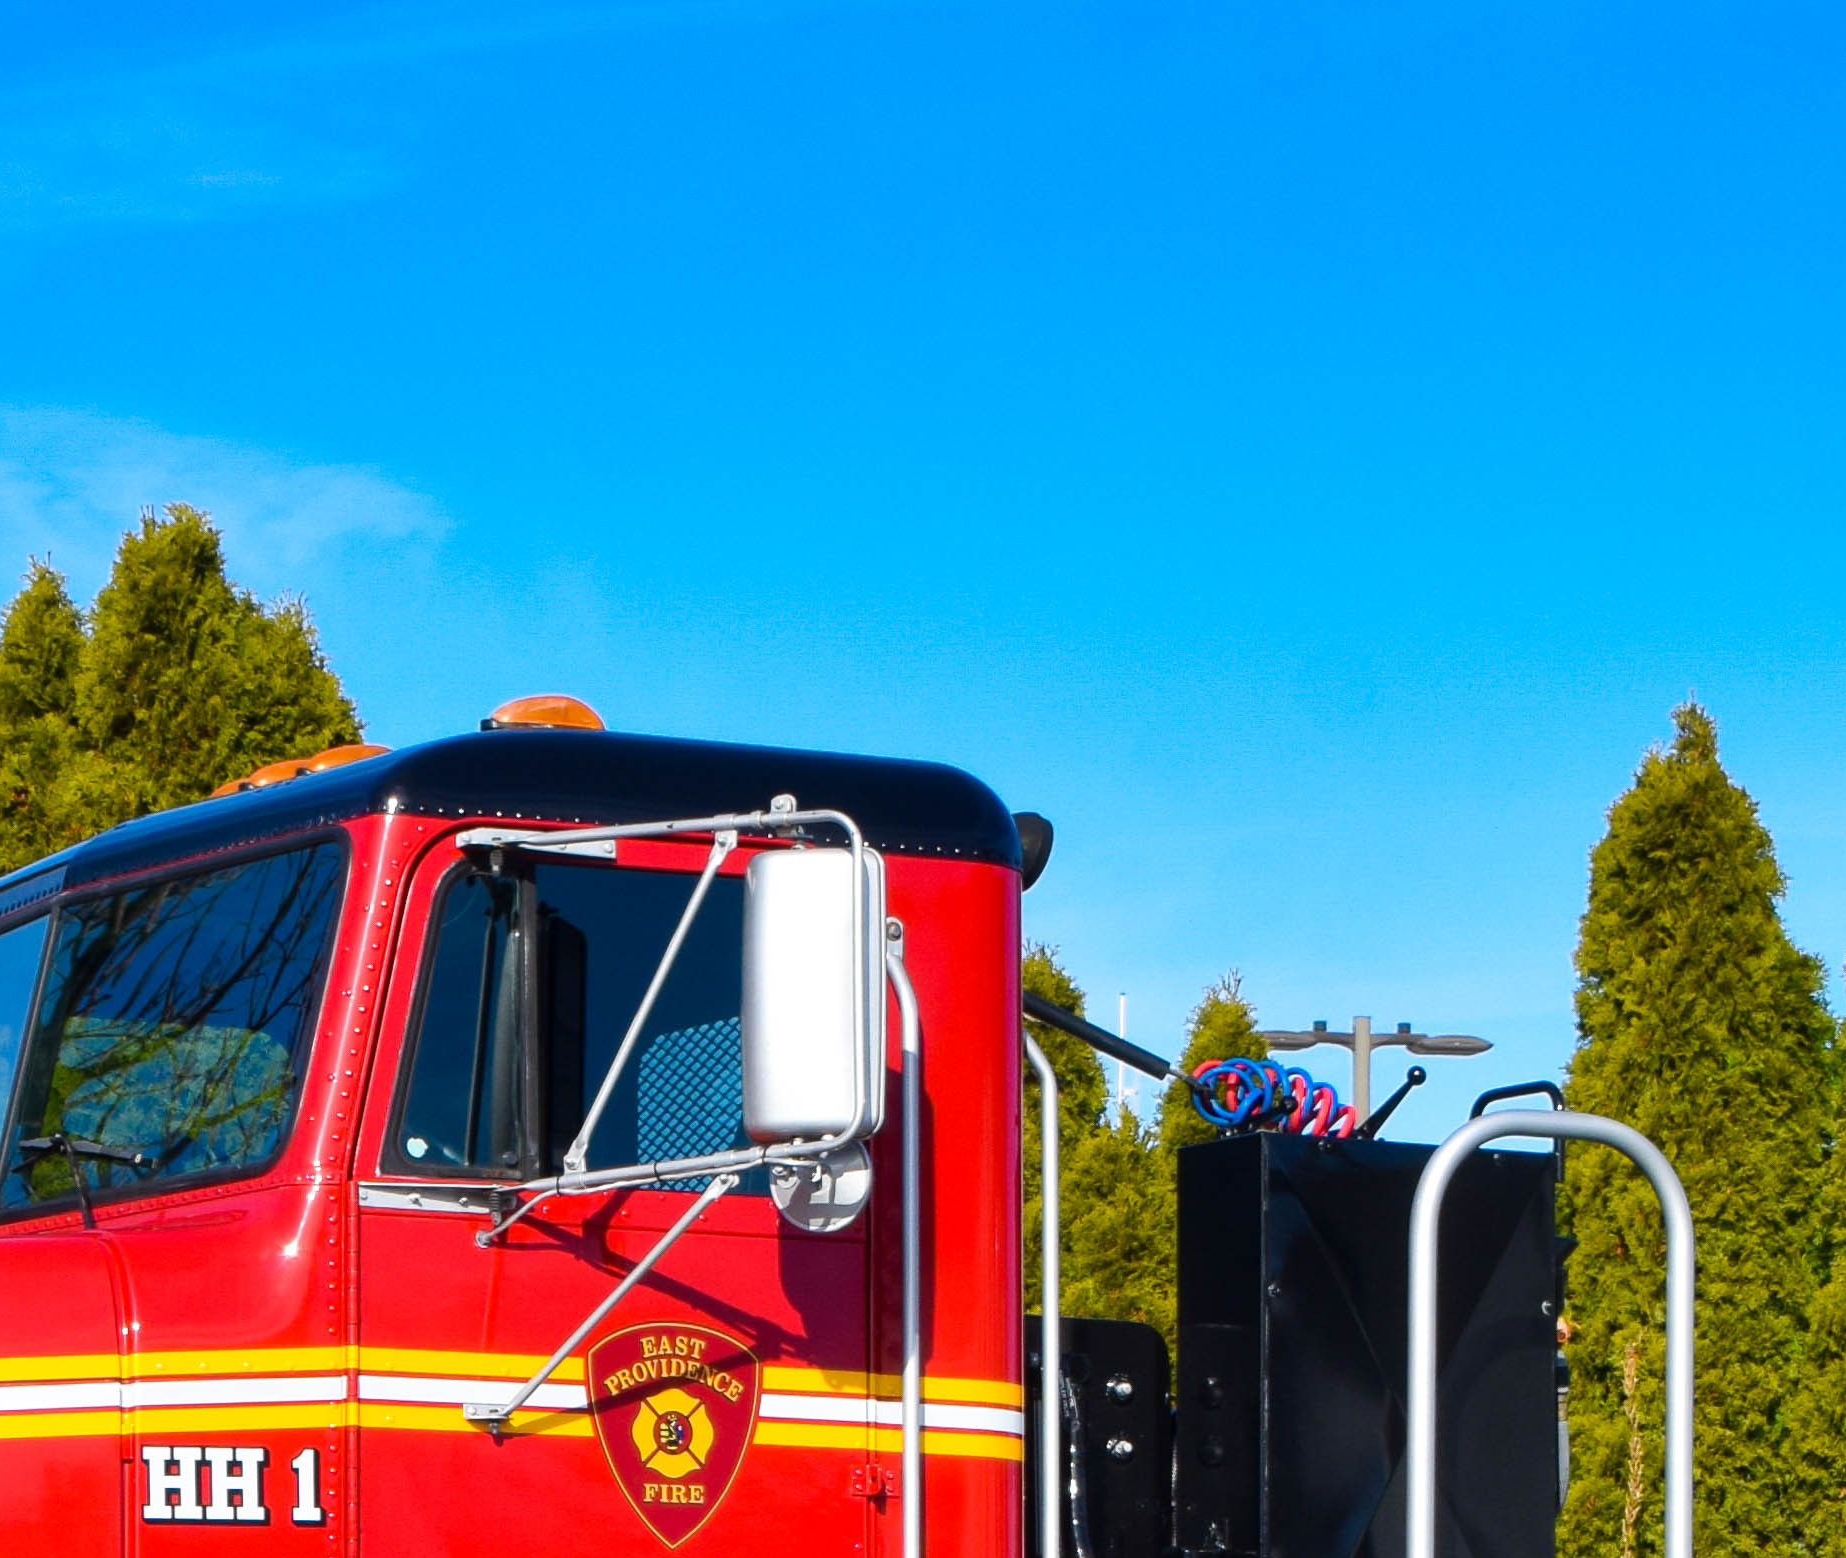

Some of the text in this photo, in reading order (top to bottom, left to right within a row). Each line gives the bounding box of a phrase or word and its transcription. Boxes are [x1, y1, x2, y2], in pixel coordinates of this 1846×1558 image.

[640, 1335, 705, 1360] EAST
[604, 1358, 744, 1402] PROVIDENCE
[141, 1445, 327, 1526] HH 1
[643, 1483, 704, 1504] FIRE
